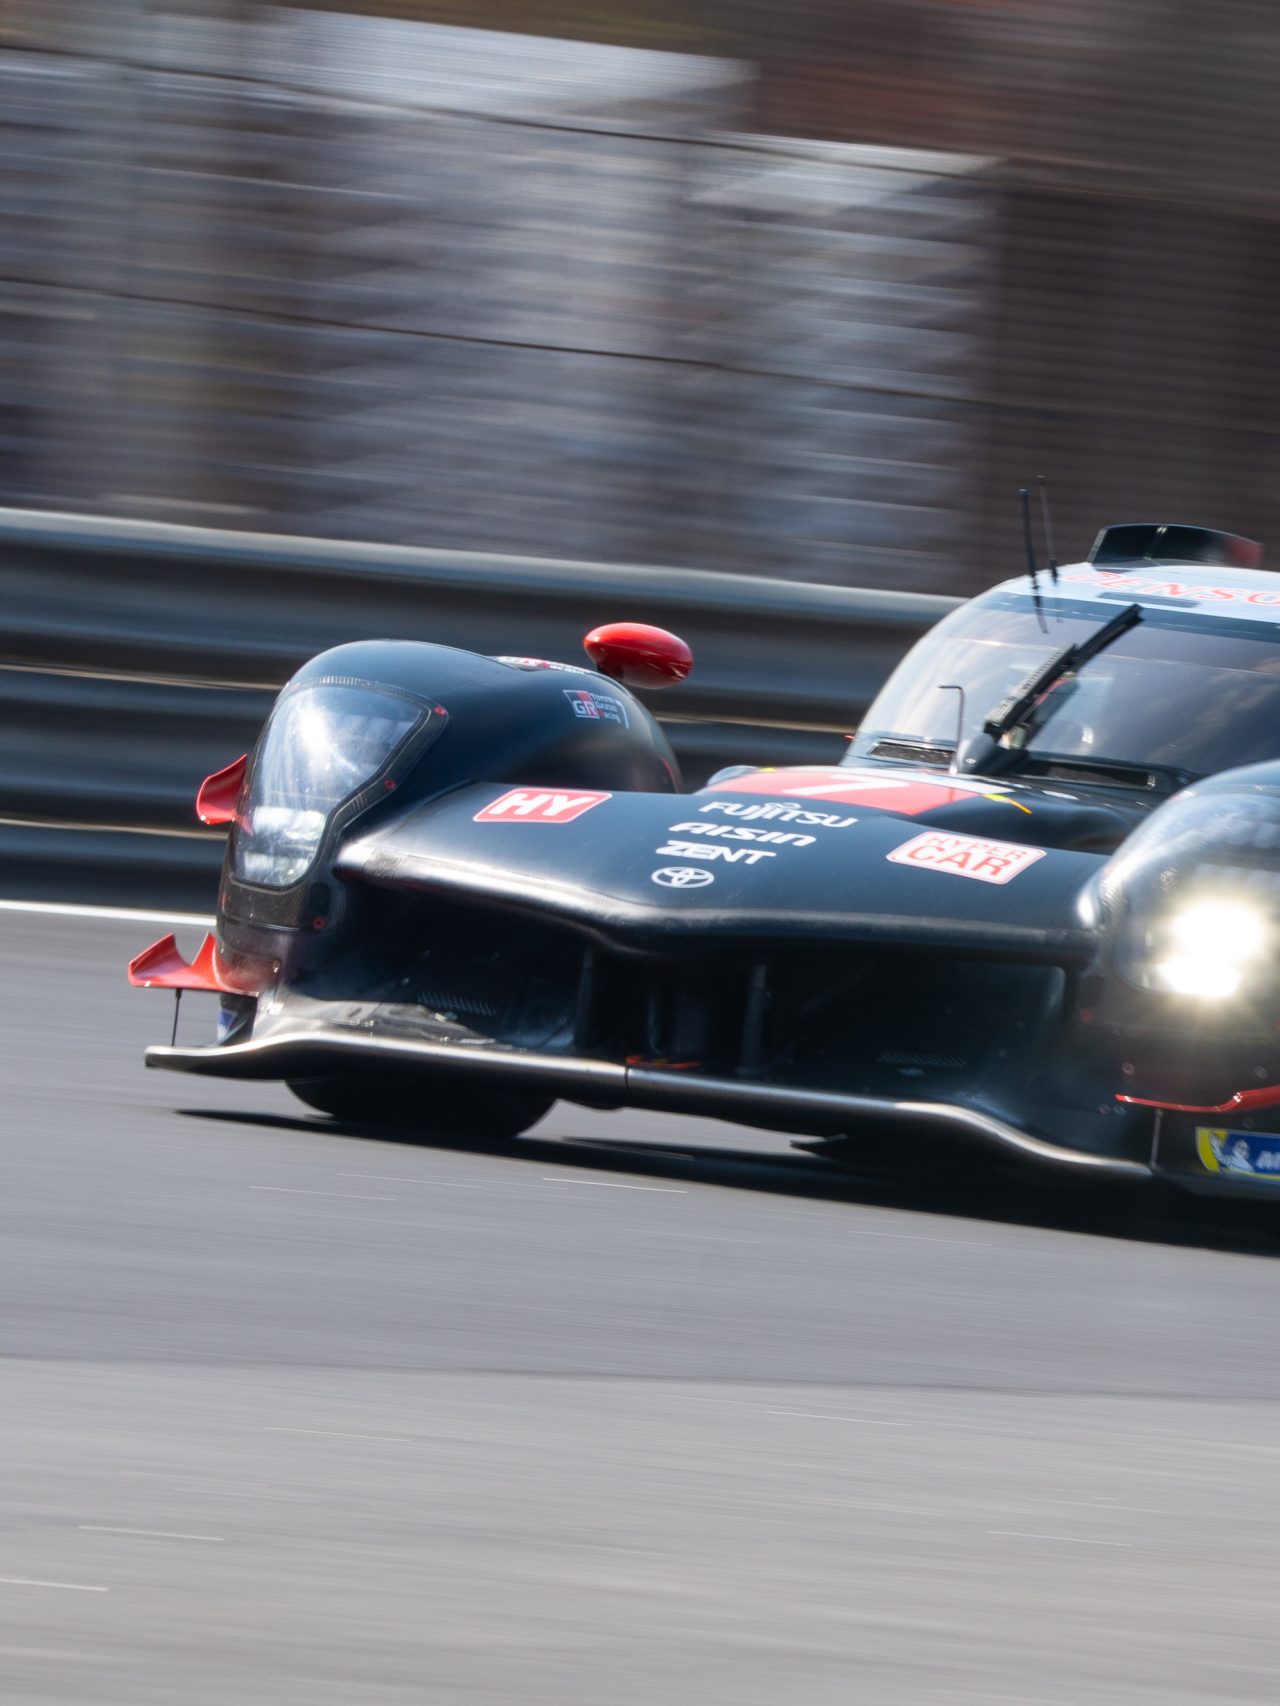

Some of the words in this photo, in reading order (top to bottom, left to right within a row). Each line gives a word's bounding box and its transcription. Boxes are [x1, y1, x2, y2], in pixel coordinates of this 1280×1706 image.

[573, 700, 597, 715] GR
[488, 793, 597, 816] HY
[698, 801, 859, 828] FUJITSU
[668, 822, 817, 847] AISIN
[655, 840, 777, 865] ZENT
[907, 846, 1012, 876] CAR
[926, 836, 1028, 861] HYPER
